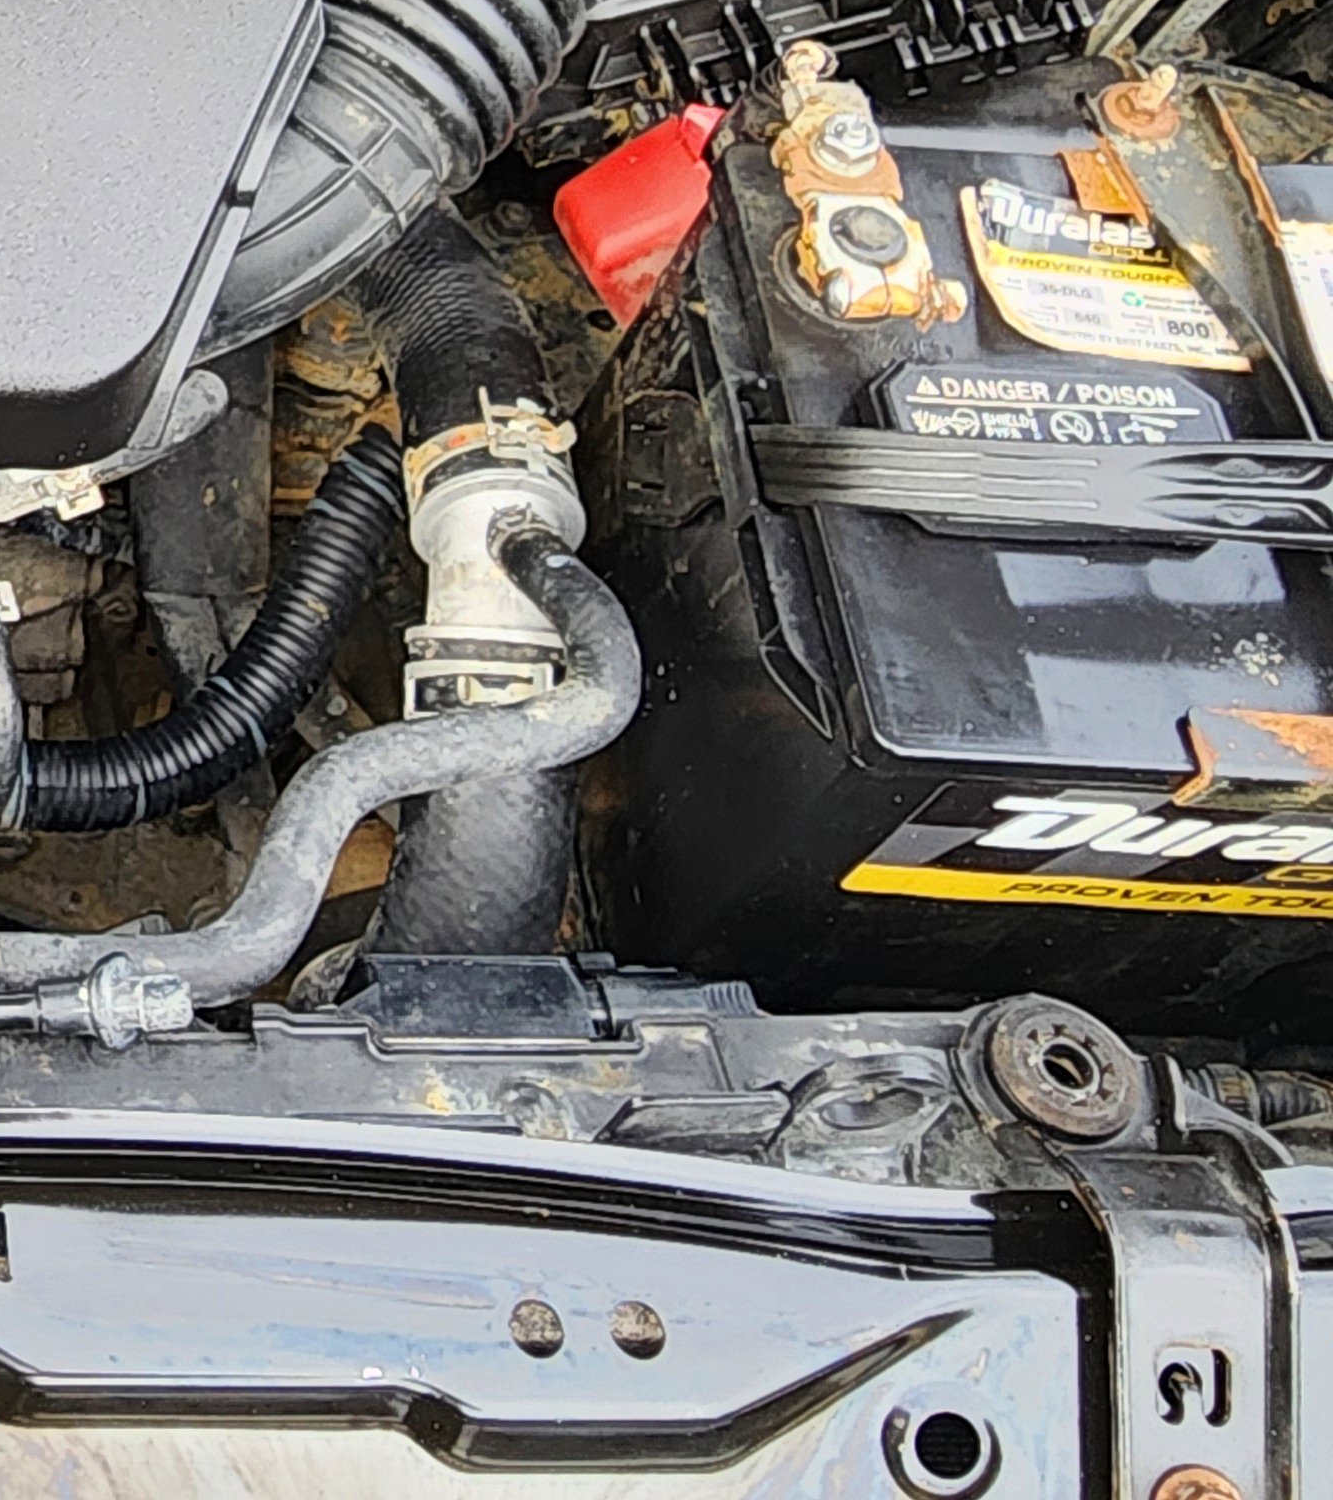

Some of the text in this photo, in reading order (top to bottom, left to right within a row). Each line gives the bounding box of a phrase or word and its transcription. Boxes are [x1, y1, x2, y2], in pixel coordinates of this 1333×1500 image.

[980, 180, 1155, 250] Duralas
[1007, 254, 1092, 276] PROVEN
[1167, 319, 1211, 339] 800
[940, 377, 1051, 402] DANGER
[1075, 383, 1177, 407] POISON
[975, 796, 1333, 864] Dura
[999, 882, 1233, 904] PROVEN
